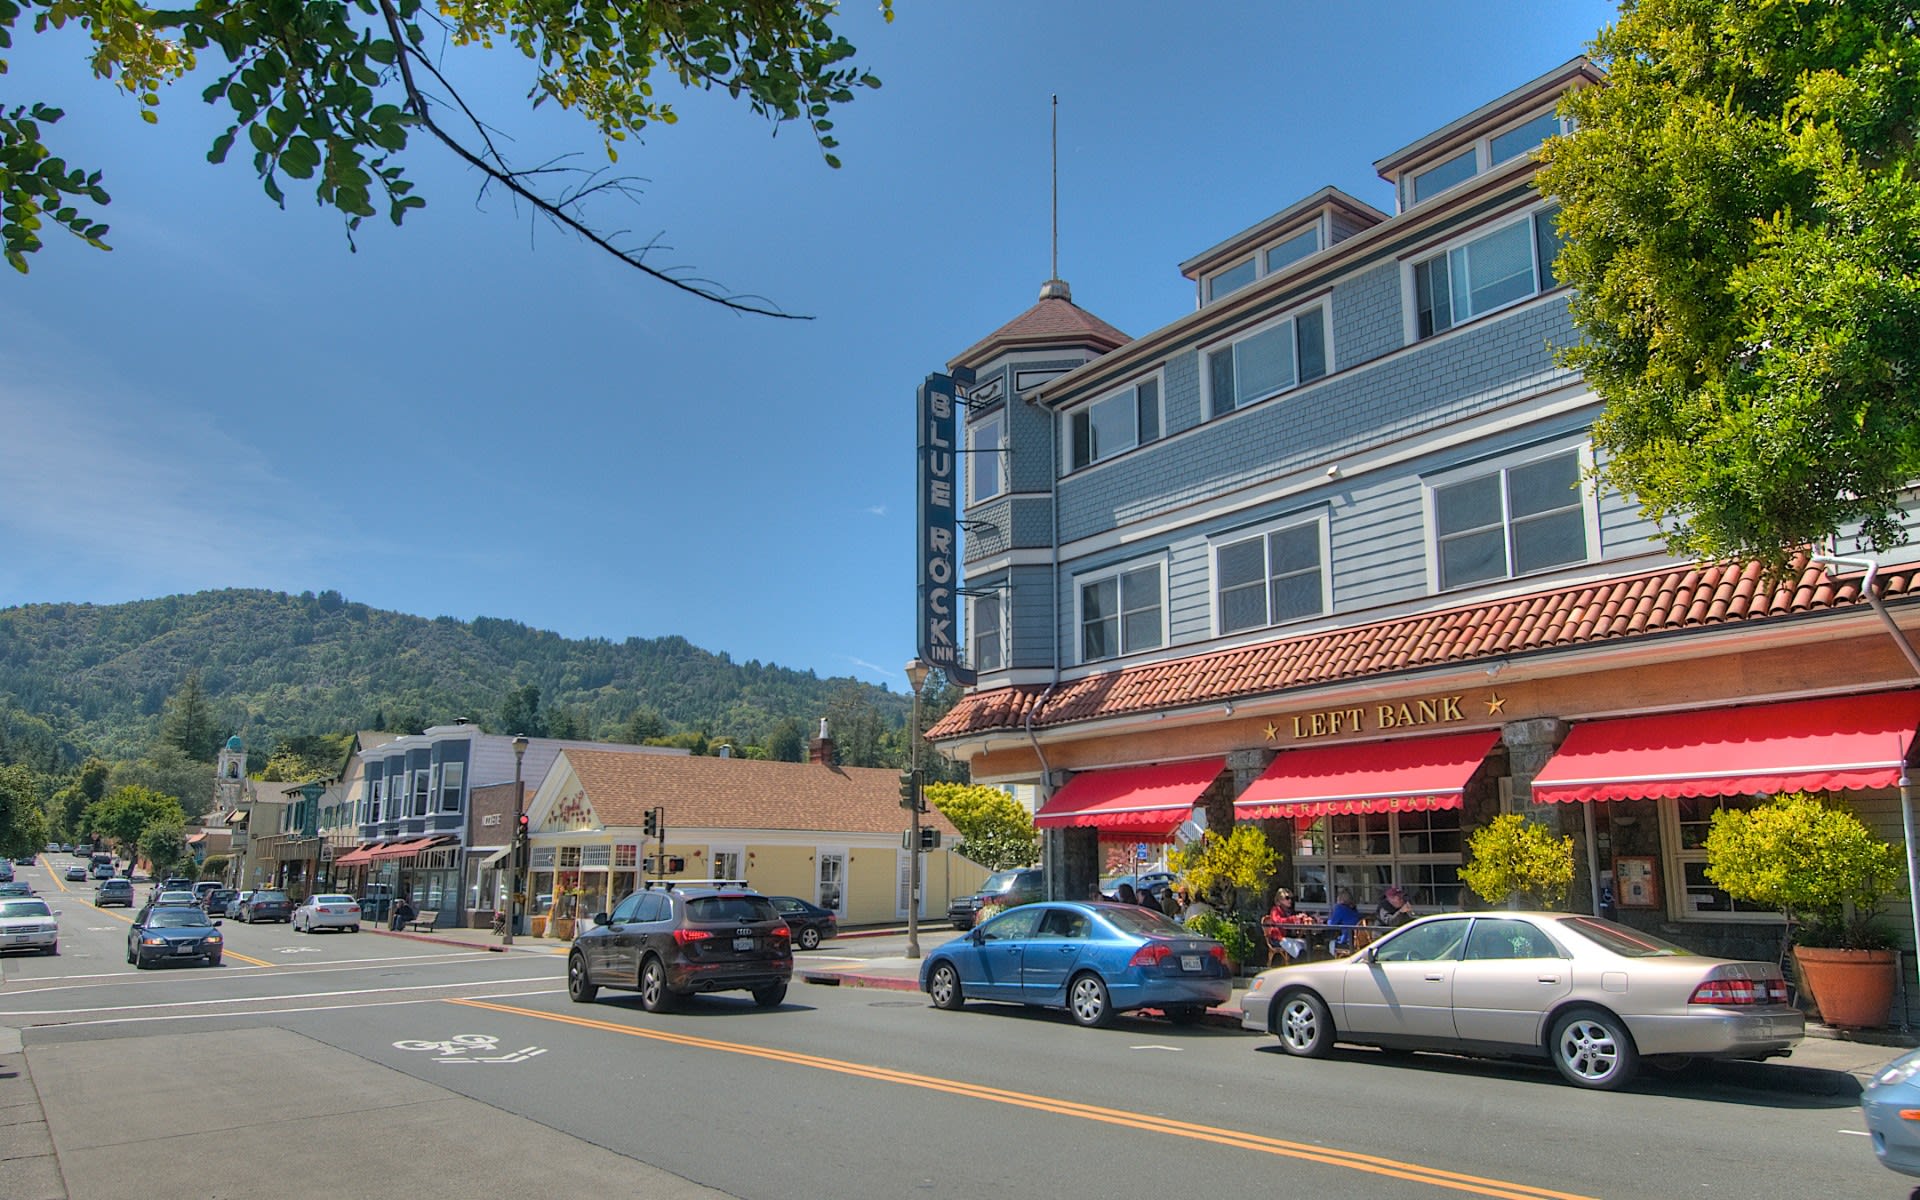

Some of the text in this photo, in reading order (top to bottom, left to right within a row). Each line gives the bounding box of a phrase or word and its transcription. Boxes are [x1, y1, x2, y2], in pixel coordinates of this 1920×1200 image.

[928, 391, 953, 646] BLUE ROCK
[931, 646, 954, 662] INN
[1292, 695, 1465, 739] LEFT BANK
[1254, 795, 1436, 816] AMERICAN BAR
